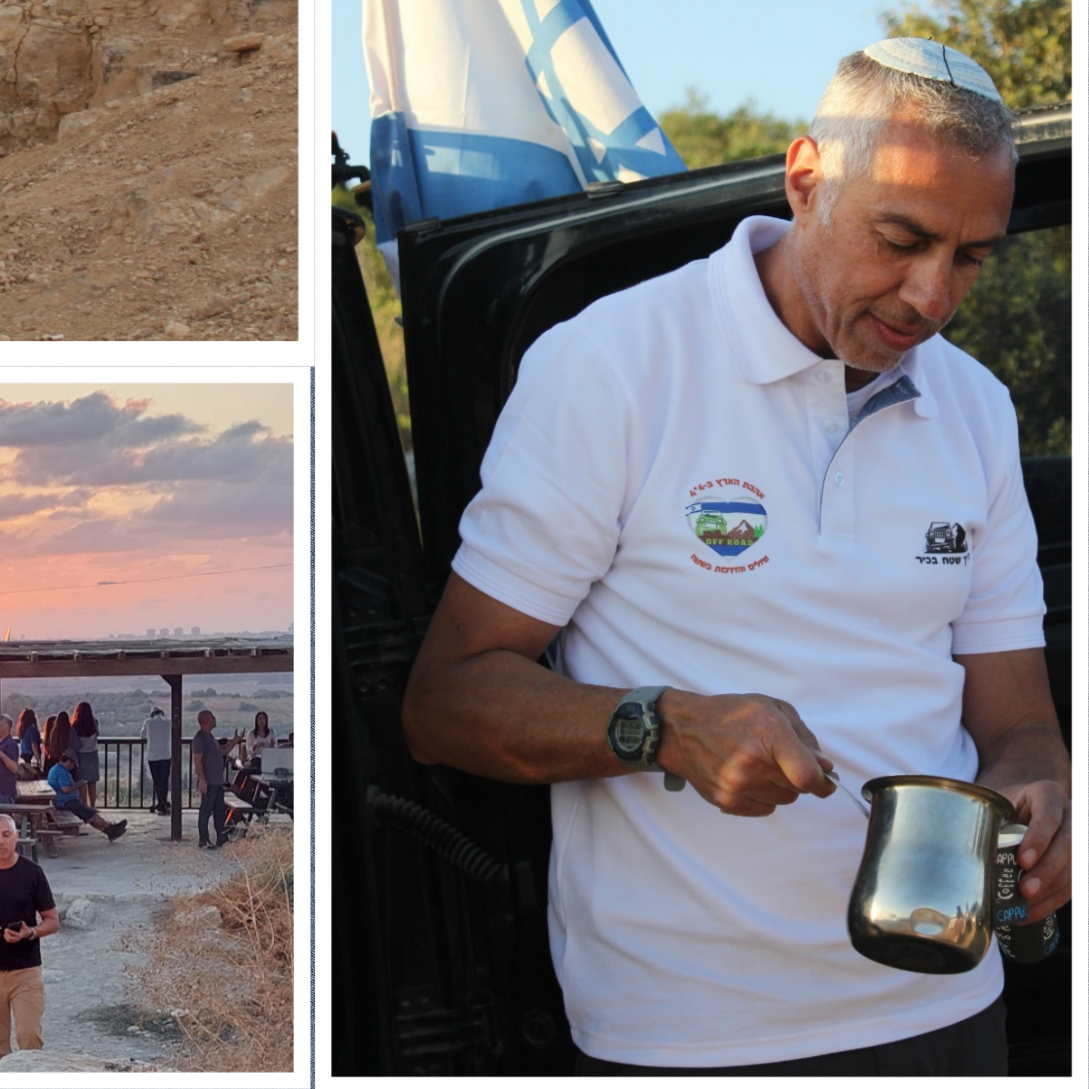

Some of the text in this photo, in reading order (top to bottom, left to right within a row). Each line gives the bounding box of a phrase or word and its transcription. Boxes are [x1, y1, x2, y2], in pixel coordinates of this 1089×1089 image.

[715, 478, 740, 488] הארץ
[742, 481, 765, 500] אהבת
[705, 538, 753, 546] OFF ROAD
[915, 556, 938, 565] בכיר
[942, 556, 961, 565] שטח
[997, 868, 1015, 900] Coffee
